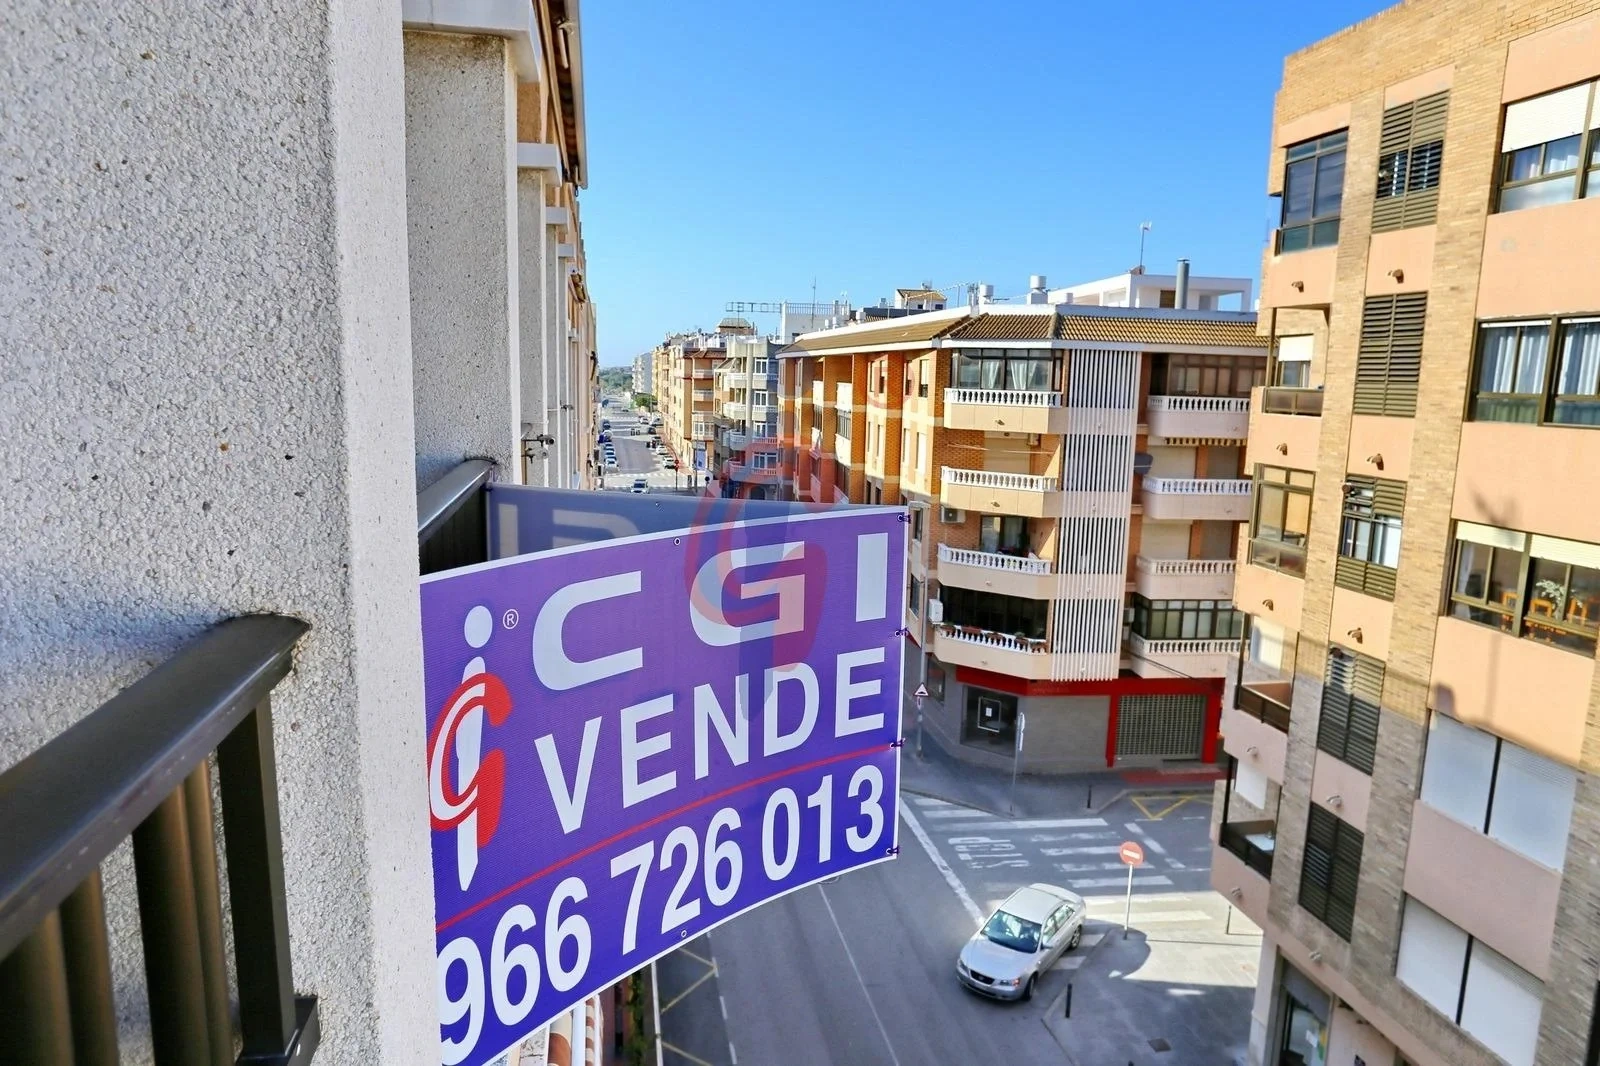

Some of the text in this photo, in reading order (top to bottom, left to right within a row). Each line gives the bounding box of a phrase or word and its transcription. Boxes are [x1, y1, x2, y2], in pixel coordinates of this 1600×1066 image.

[534, 646, 886, 834] VENDE
[437, 764, 884, 1065] 966 726 013
[947, 837, 1029, 868] STOP
